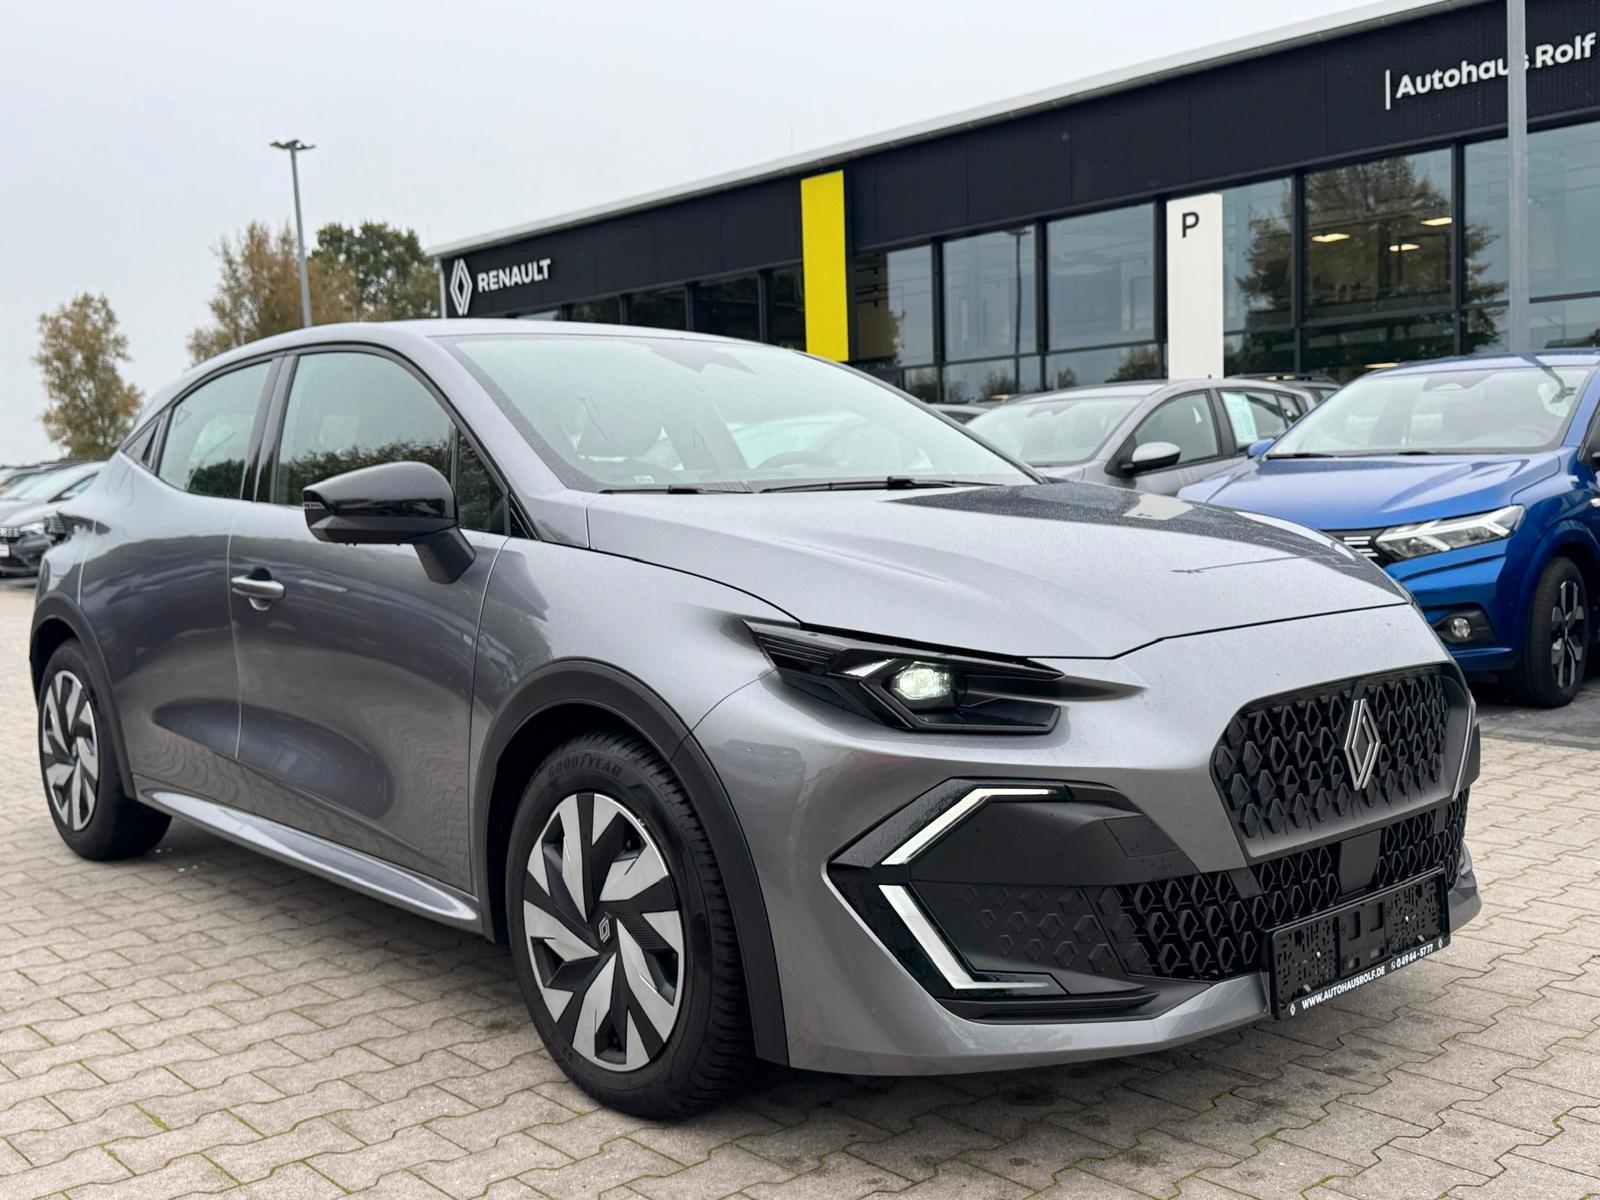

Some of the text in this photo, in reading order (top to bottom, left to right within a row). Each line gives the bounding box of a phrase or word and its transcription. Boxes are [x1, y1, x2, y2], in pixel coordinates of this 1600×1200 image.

[1535, 32, 1596, 68] Rolf
[1182, 211, 1200, 239] P
[477, 258, 551, 293] RENAULT
[548, 753, 622, 778] GOODYEAR
[1301, 965, 1386, 1010] WWW.AUTOHAUSROLF.DE
